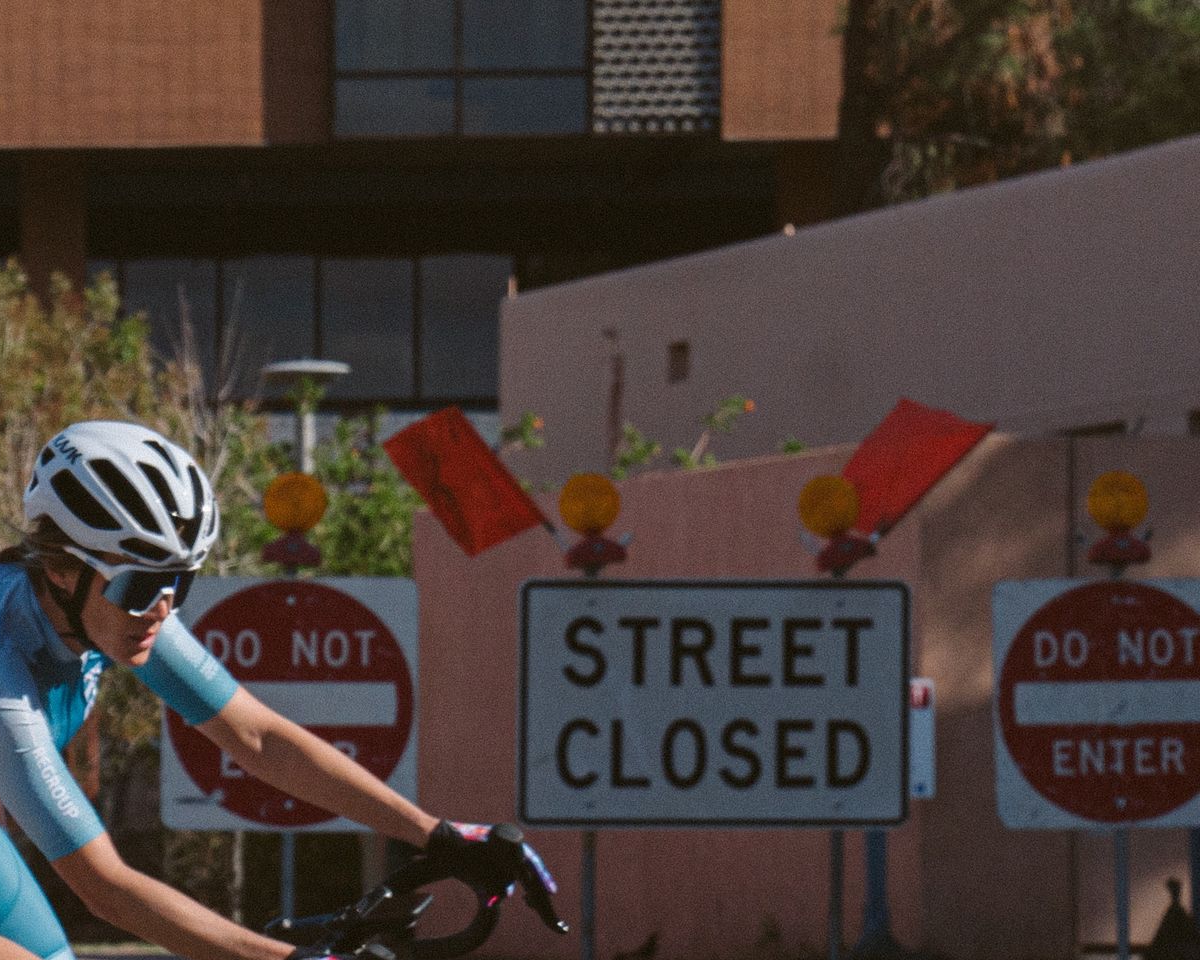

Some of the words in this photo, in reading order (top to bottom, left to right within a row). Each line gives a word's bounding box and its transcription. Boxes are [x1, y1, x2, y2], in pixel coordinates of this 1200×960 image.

[206, 629, 261, 668] DO
[292, 629, 376, 668] NOT
[562, 616, 874, 688] STREET
[1033, 629, 1090, 668] DO
[1117, 627, 1200, 667] NOT
[556, 718, 871, 789] CLOSED
[1053, 737, 1186, 776] ENTER
